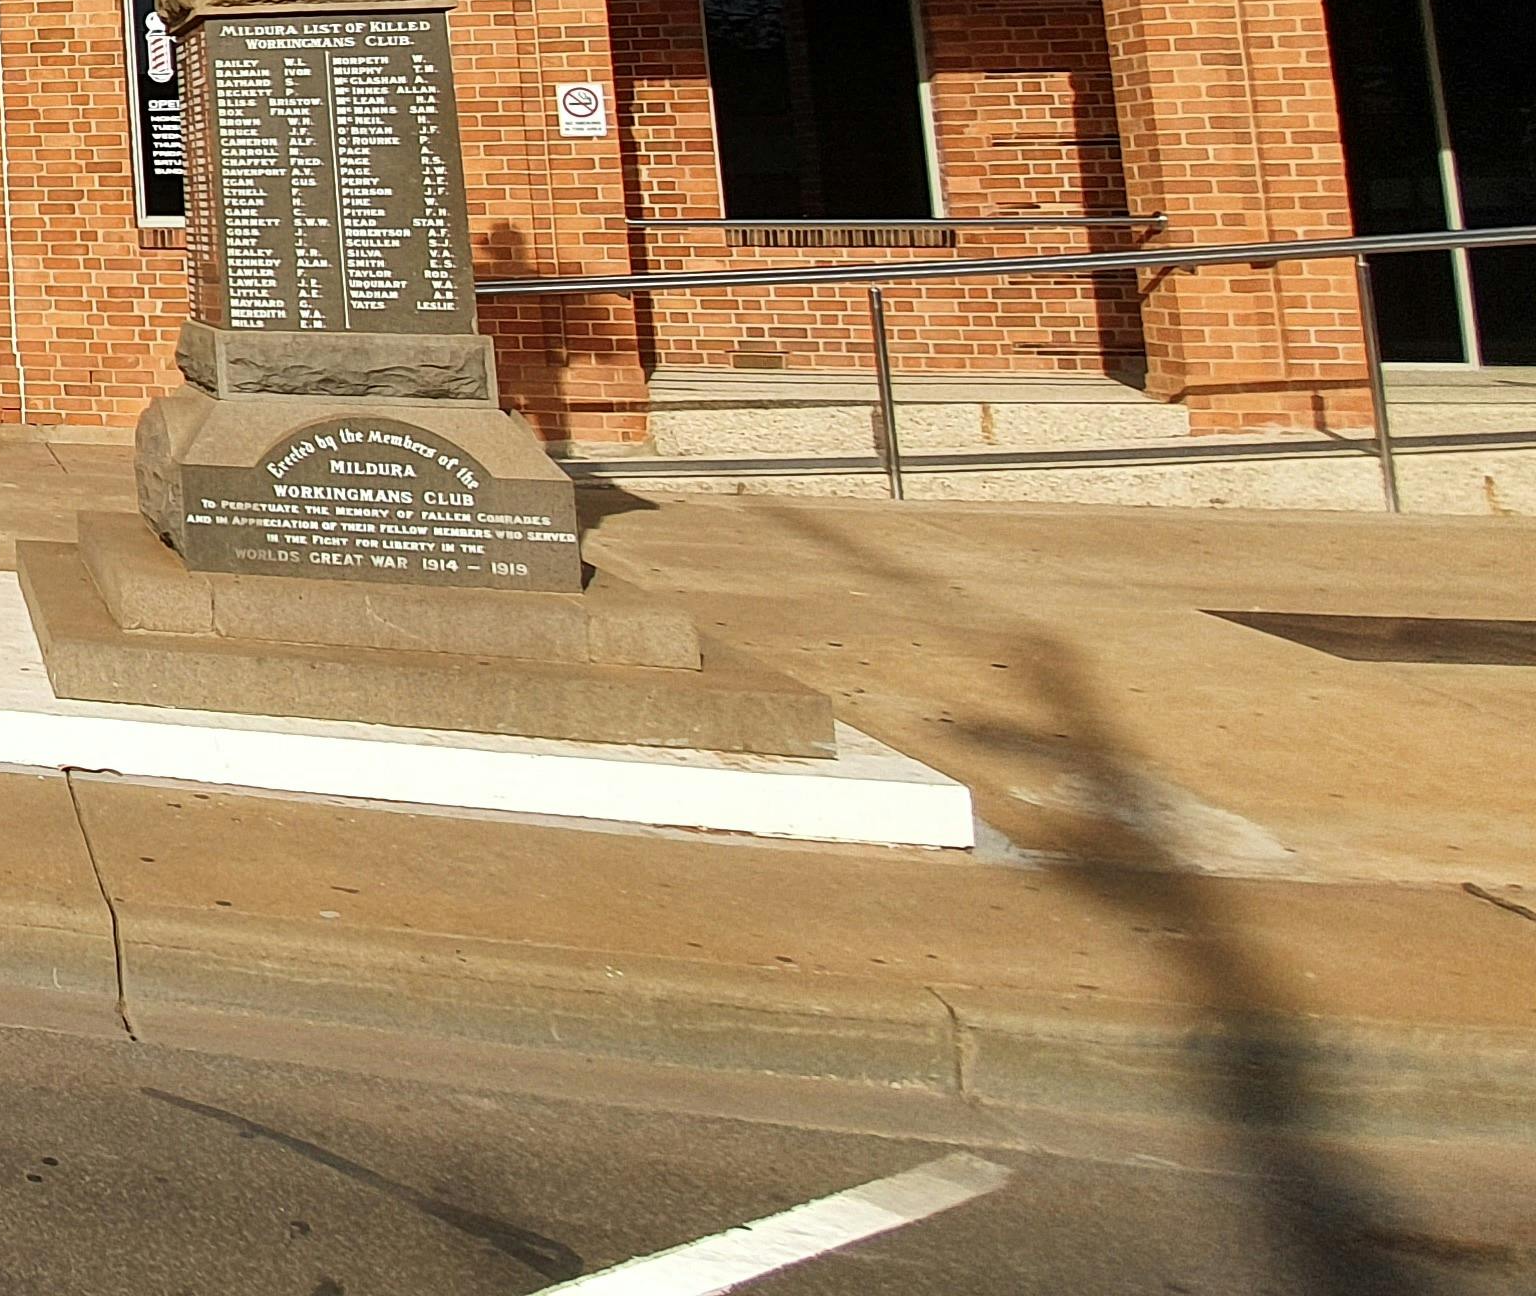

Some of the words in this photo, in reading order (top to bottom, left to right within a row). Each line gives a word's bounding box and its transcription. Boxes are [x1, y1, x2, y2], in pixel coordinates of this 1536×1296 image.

[220, 25, 299, 36] MILDURA
[304, 24, 342, 34] LIST
[345, 23, 367, 33] OF
[370, 21, 430, 32] KILLED
[245, 37, 356, 49] WORKINGMANS
[365, 36, 415, 46] CLUB.
[215, 60, 260, 68] BAILEY
[333, 56, 389, 65] MORPETH
[216, 69, 271, 77] BALMAIN
[334, 67, 383, 75] MURPHY
[217, 89, 273, 97] BECKETT
[218, 99, 257, 107] BLISS
[270, 108, 311, 116] FRANK
[219, 118, 261, 126] BROWN
[220, 128, 259, 136] BRUCE
[221, 138, 279, 146] CAMERON
[221, 148, 280, 156] CARROLL
[339, 147, 371, 155] PACK
[222, 158, 278, 166] CHAFFEY
[340, 157, 371, 165] PAGE
[222, 168, 287, 176] DAVENPORT
[340, 167, 371, 175] PAGE
[223, 178, 255, 186] EGAN
[342, 188, 393, 196] PIERSON
[224, 198, 264, 206] FEGAN
[226, 218, 281, 226] GARNETT
[344, 218, 377, 227] READ
[345, 228, 411, 237] ROBERTSON
[227, 237, 258, 246] HART
[227, 248, 274, 257] HEALEY
[347, 249, 382, 257] SILVA
[228, 258, 282, 267] KENNEDY
[348, 259, 385, 267] SMITH
[228, 268, 275, 277] LAWLER
[348, 269, 392, 278] TAYLOR
[229, 277, 277, 287] LAWLER
[349, 279, 408, 289] URQUHART
[230, 288, 270, 297] LITTLE
[350, 290, 399, 299] WADHAM
[230, 298, 285, 307] MAYNARD
[350, 300, 386, 309] YATES
[231, 309, 287, 318] MEREDITH
[232, 319, 265, 328] MILLS
[266, 441, 316, 479] Erected
[315, 434, 338, 451] by
[339, 428, 364, 444] the
[367, 430, 438, 458] Members
[438, 455, 459, 470] of
[456, 467, 479, 489] the
[330, 459, 418, 478] MILDURA
[273, 484, 415, 504] WORKINGMANS
[424, 491, 475, 506] CLUB
[201, 499, 218, 509] TO
[221, 500, 301, 514] PERPETUATE
[304, 505, 332, 516] THE
[335, 506, 390, 518] MEMORY
[397, 510, 415, 519] OF
[421, 511, 472, 522] FALLEN
[477, 513, 552, 526] COMRADES
[186, 514, 212, 525] AND
[216, 516, 228, 525] IN
[232, 516, 319, 530] APPRECIATION
[322, 520, 336, 531] OF
[340, 522, 376, 533] THEIR
[380, 524, 429, 535] FELLOW
[433, 526, 493, 539] MEMBERS
[527, 532, 576, 544] SERVED
[266, 533, 278, 543] IN
[284, 534, 308, 545] THE
[312, 534, 349, 546] FIGHT
[355, 538, 379, 549] FOR
[382, 540, 436, 553] LIBERTY
[441, 543, 455, 552] IN
[459, 544, 486, 554] THE
[235, 548, 300, 563] WORLDS
[309, 552, 364, 567] GREAT
[370, 555, 408, 569] WAR
[423, 558, 459, 572] 1914
[491, 561, 530, 576] 1919
